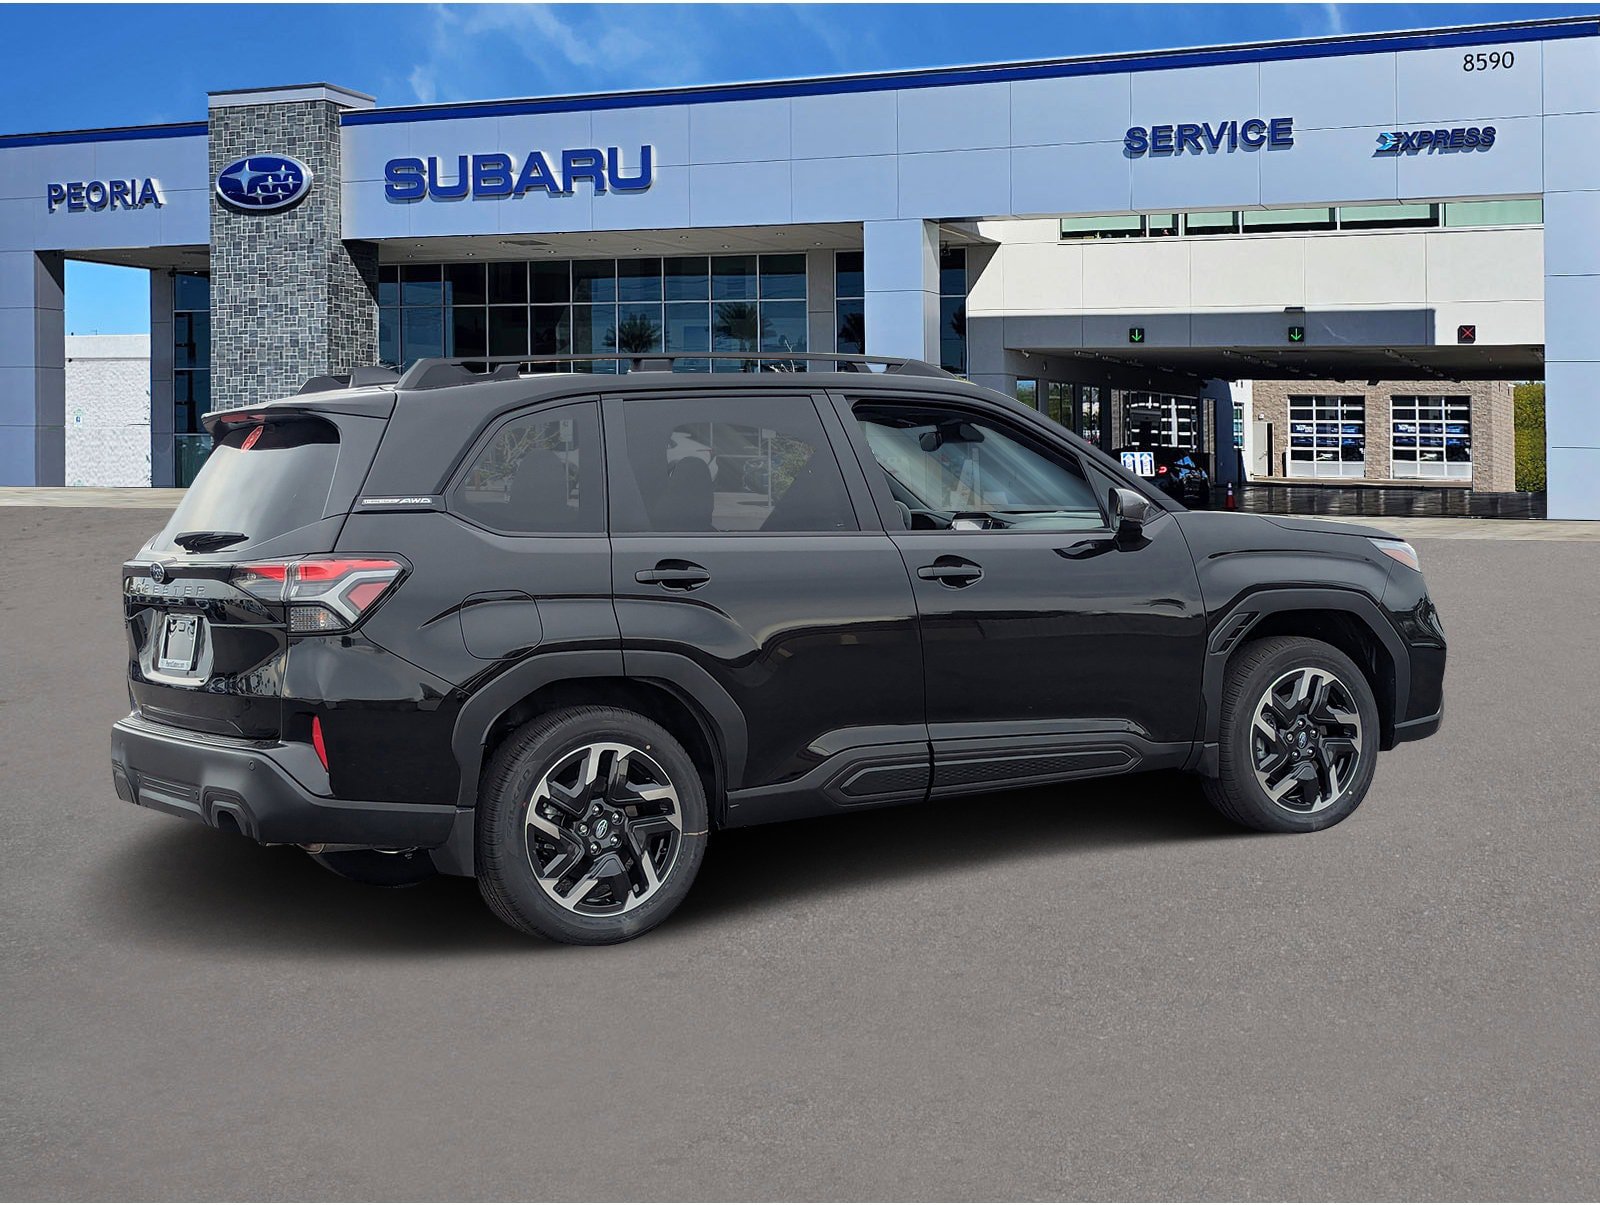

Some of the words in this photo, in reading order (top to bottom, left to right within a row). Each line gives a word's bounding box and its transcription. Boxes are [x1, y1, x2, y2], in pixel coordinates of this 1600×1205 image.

[1462, 50, 1515, 73] 8590
[1125, 116, 1294, 154] SERVICE
[1376, 125, 1497, 151] EXPRESS
[384, 145, 652, 200] SUBARU
[48, 178, 161, 210] PEORIA
